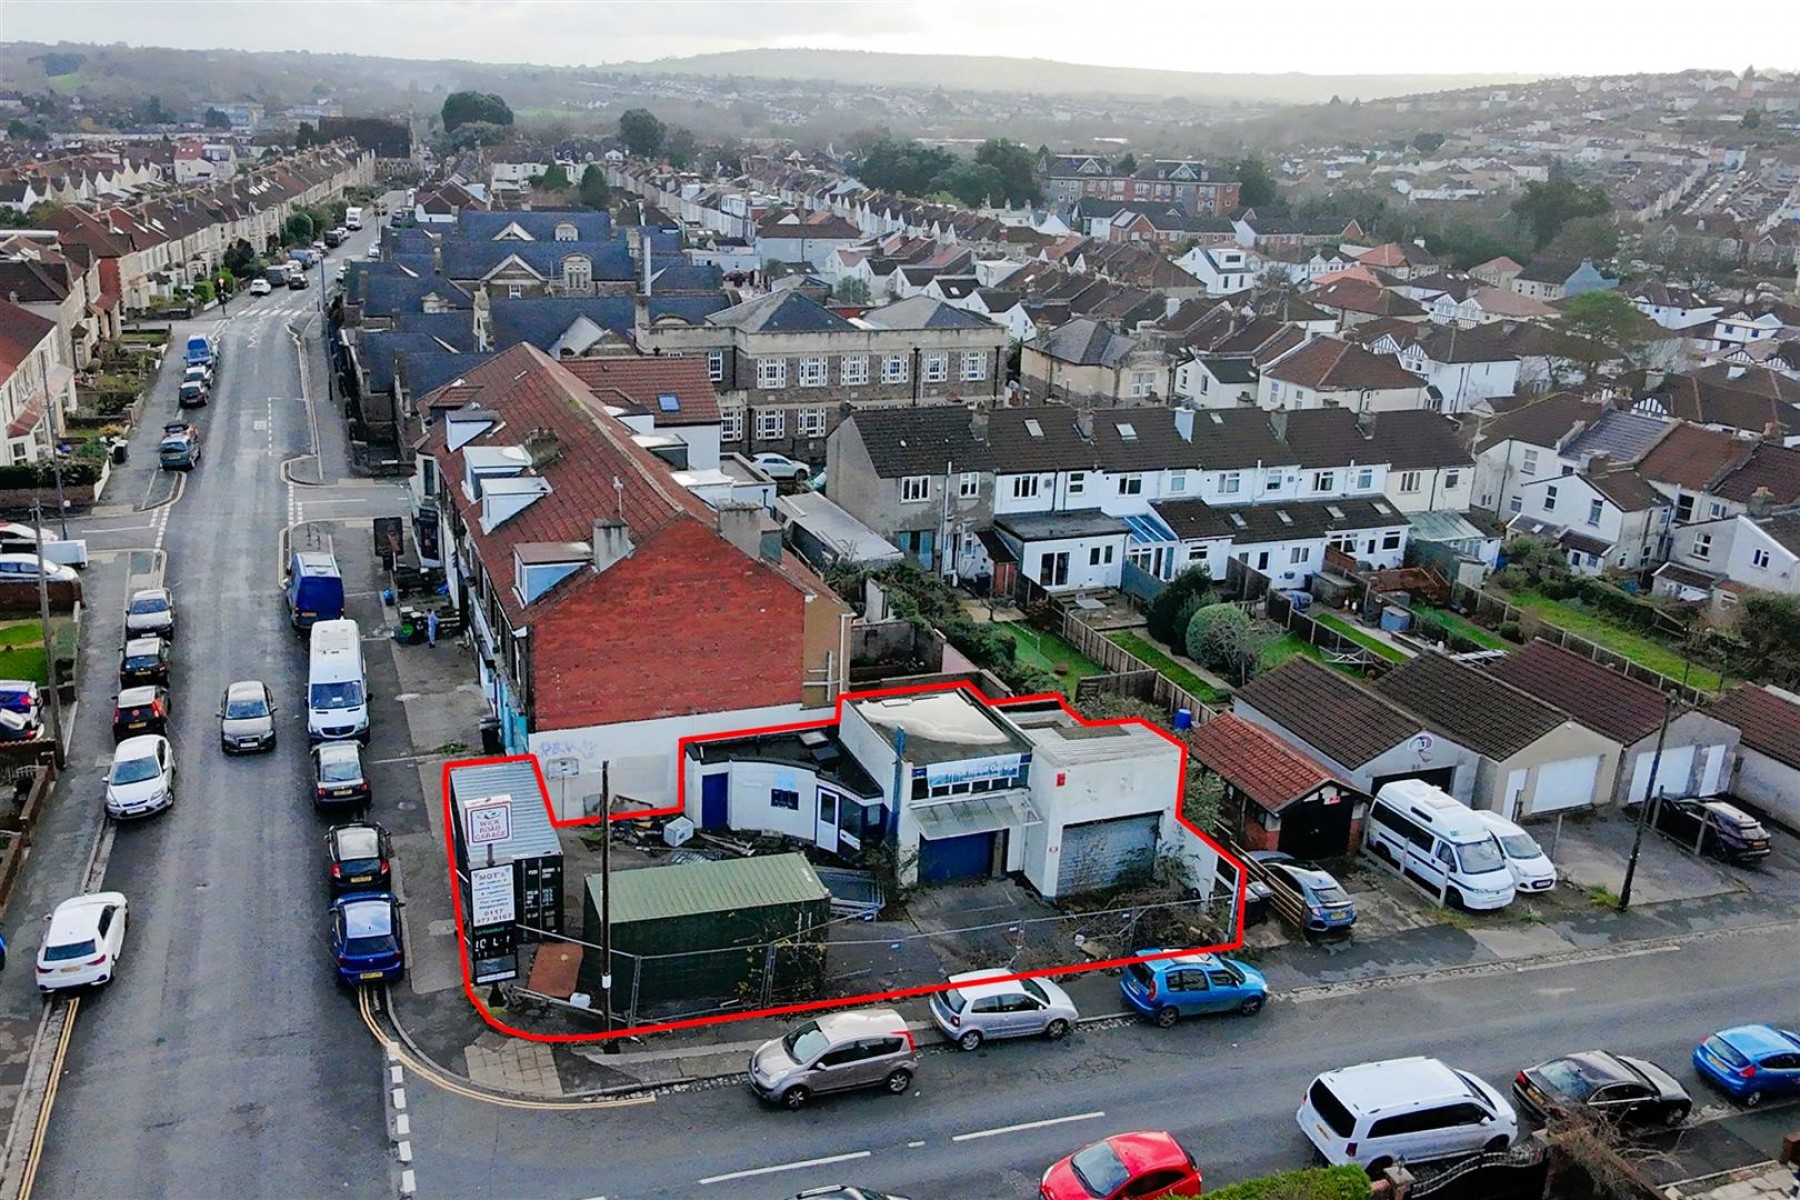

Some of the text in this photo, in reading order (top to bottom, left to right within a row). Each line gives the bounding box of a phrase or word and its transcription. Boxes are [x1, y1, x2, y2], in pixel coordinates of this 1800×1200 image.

[479, 819, 500, 827] WICK
[479, 825, 501, 833] ROAD
[475, 830, 506, 840] GARAGE
